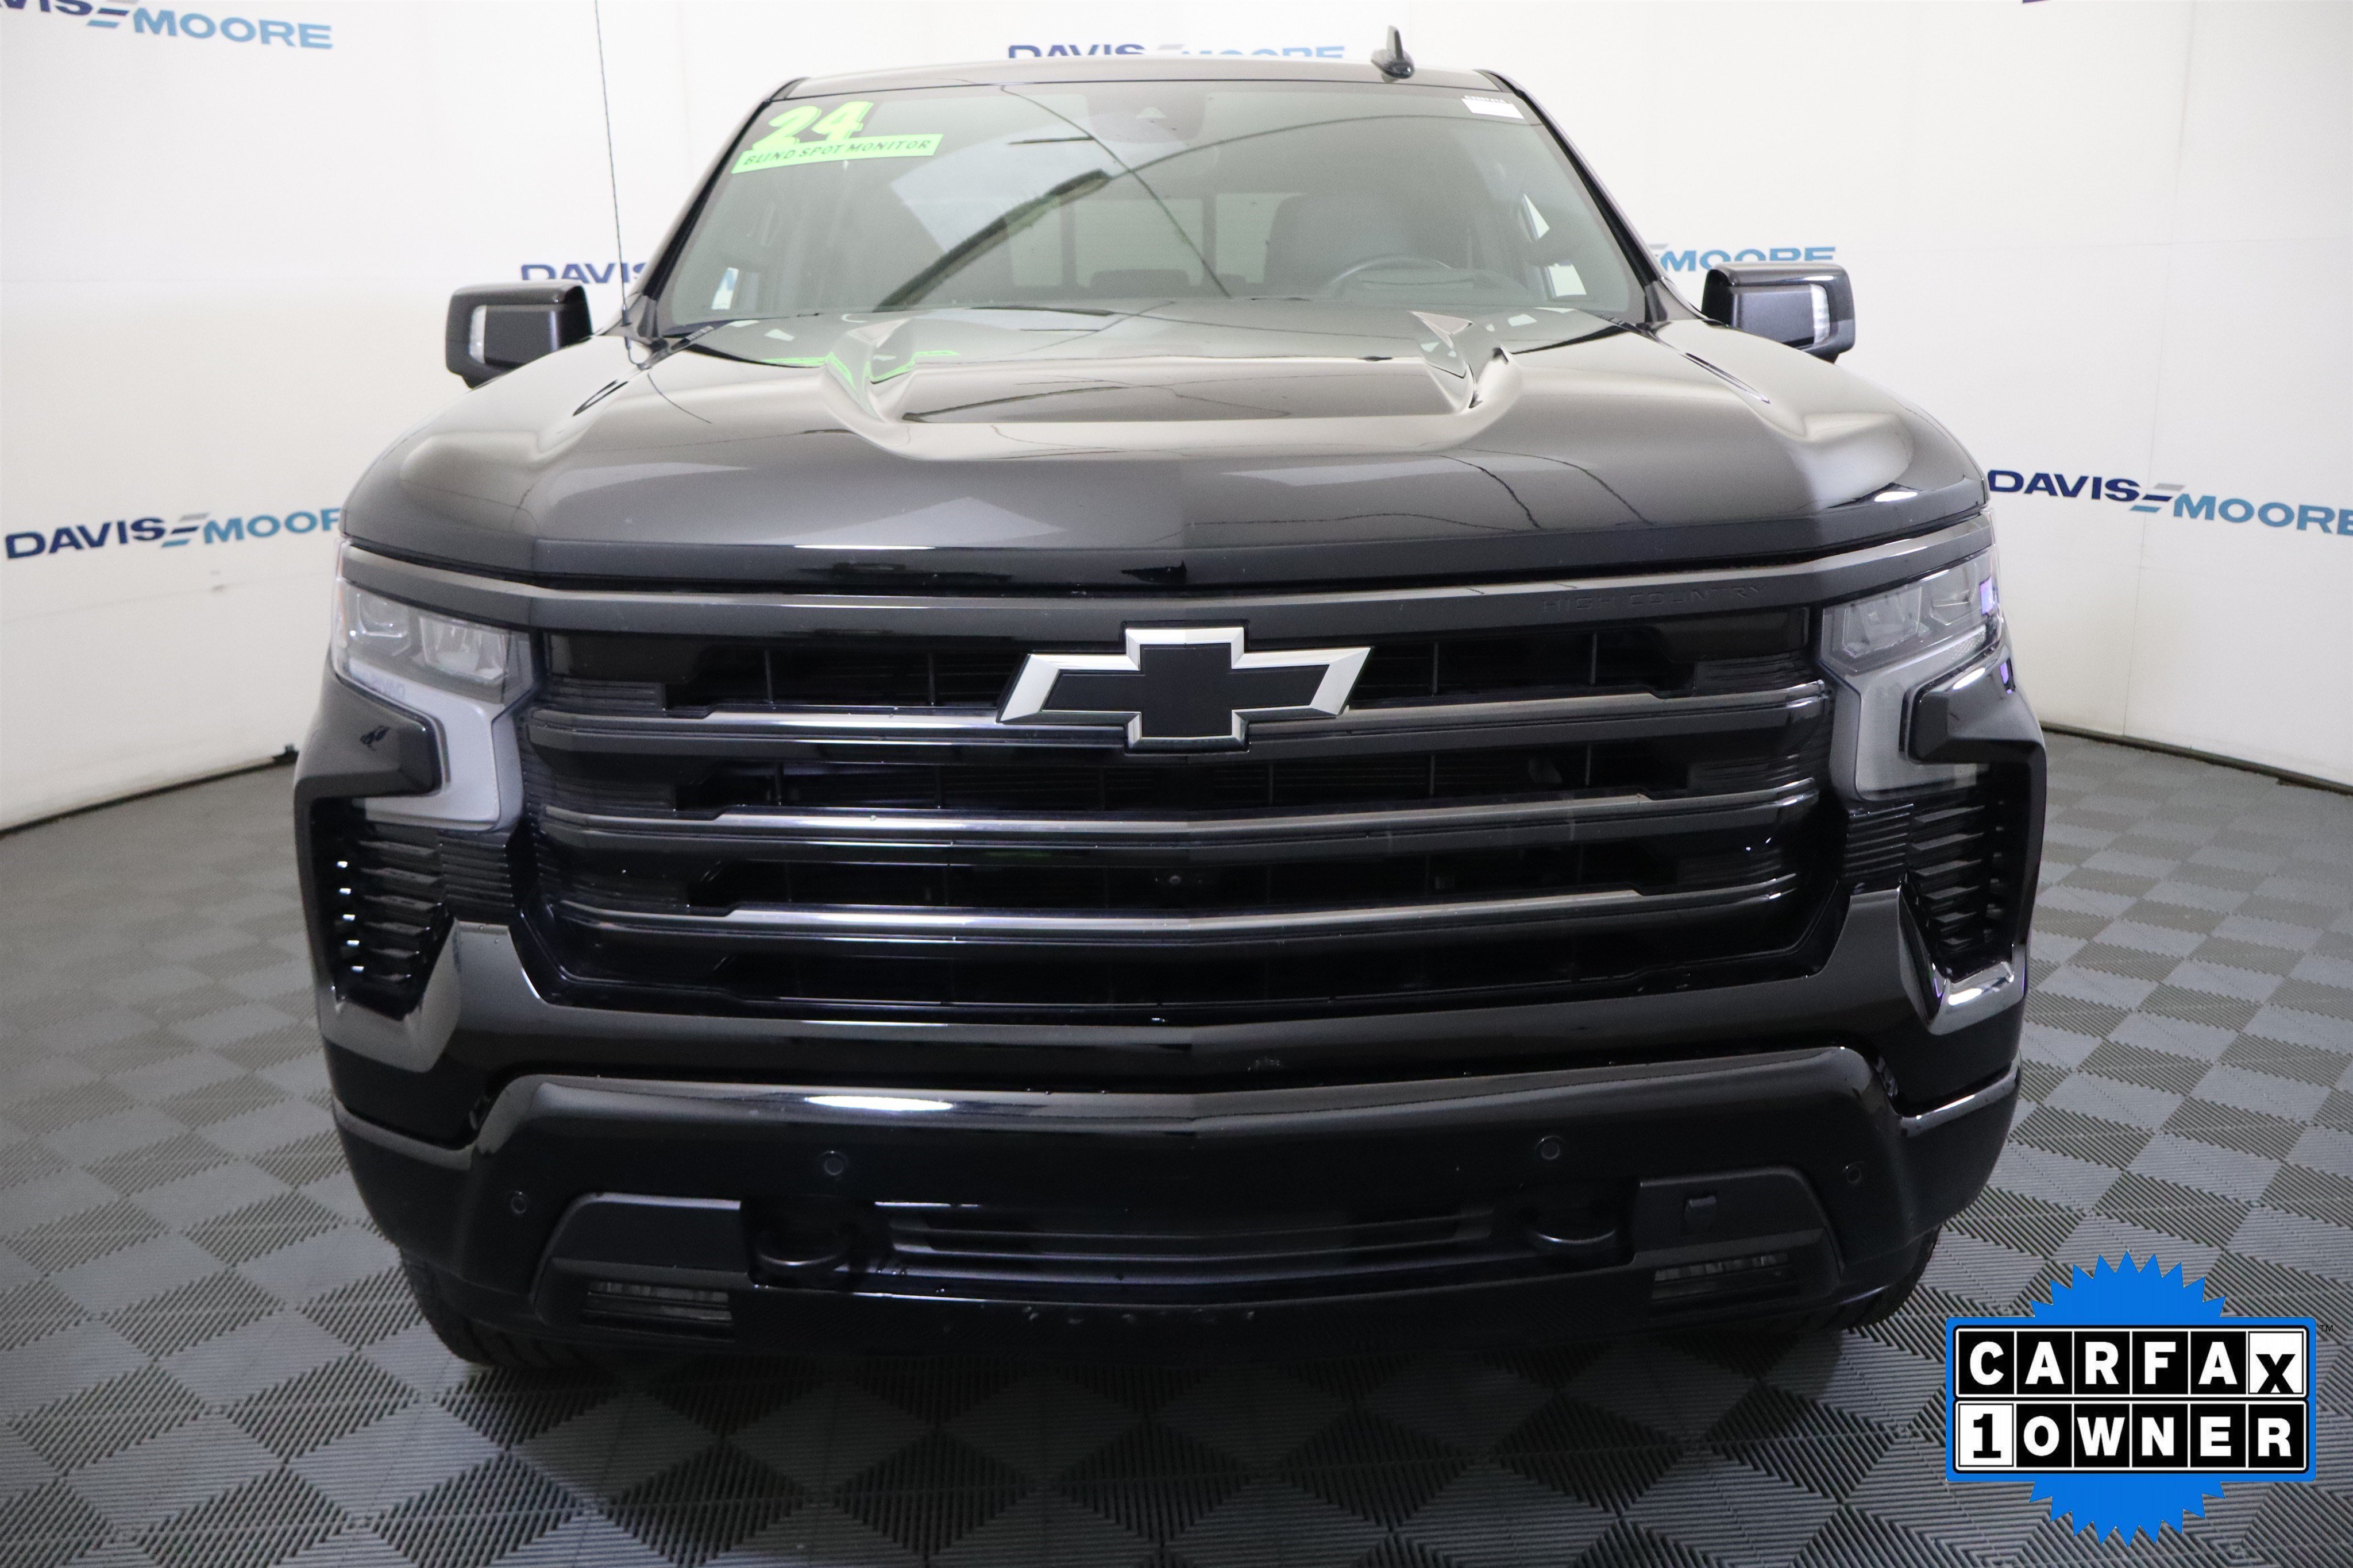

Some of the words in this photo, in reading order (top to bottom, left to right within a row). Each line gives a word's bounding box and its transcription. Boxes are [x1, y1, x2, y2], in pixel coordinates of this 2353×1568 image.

[133, 7, 333, 49] MOORE
[751, 101, 874, 152] 24
[743, 149, 796, 165] BLIND
[799, 144, 841, 157] SPOT
[844, 140, 931, 153] MONITOR
[1987, 469, 2140, 503] DAVIS
[5, 517, 166, 559] DAVIS
[1542, 595, 1615, 612] HIGH
[1629, 584, 1769, 605] COUNTRY
